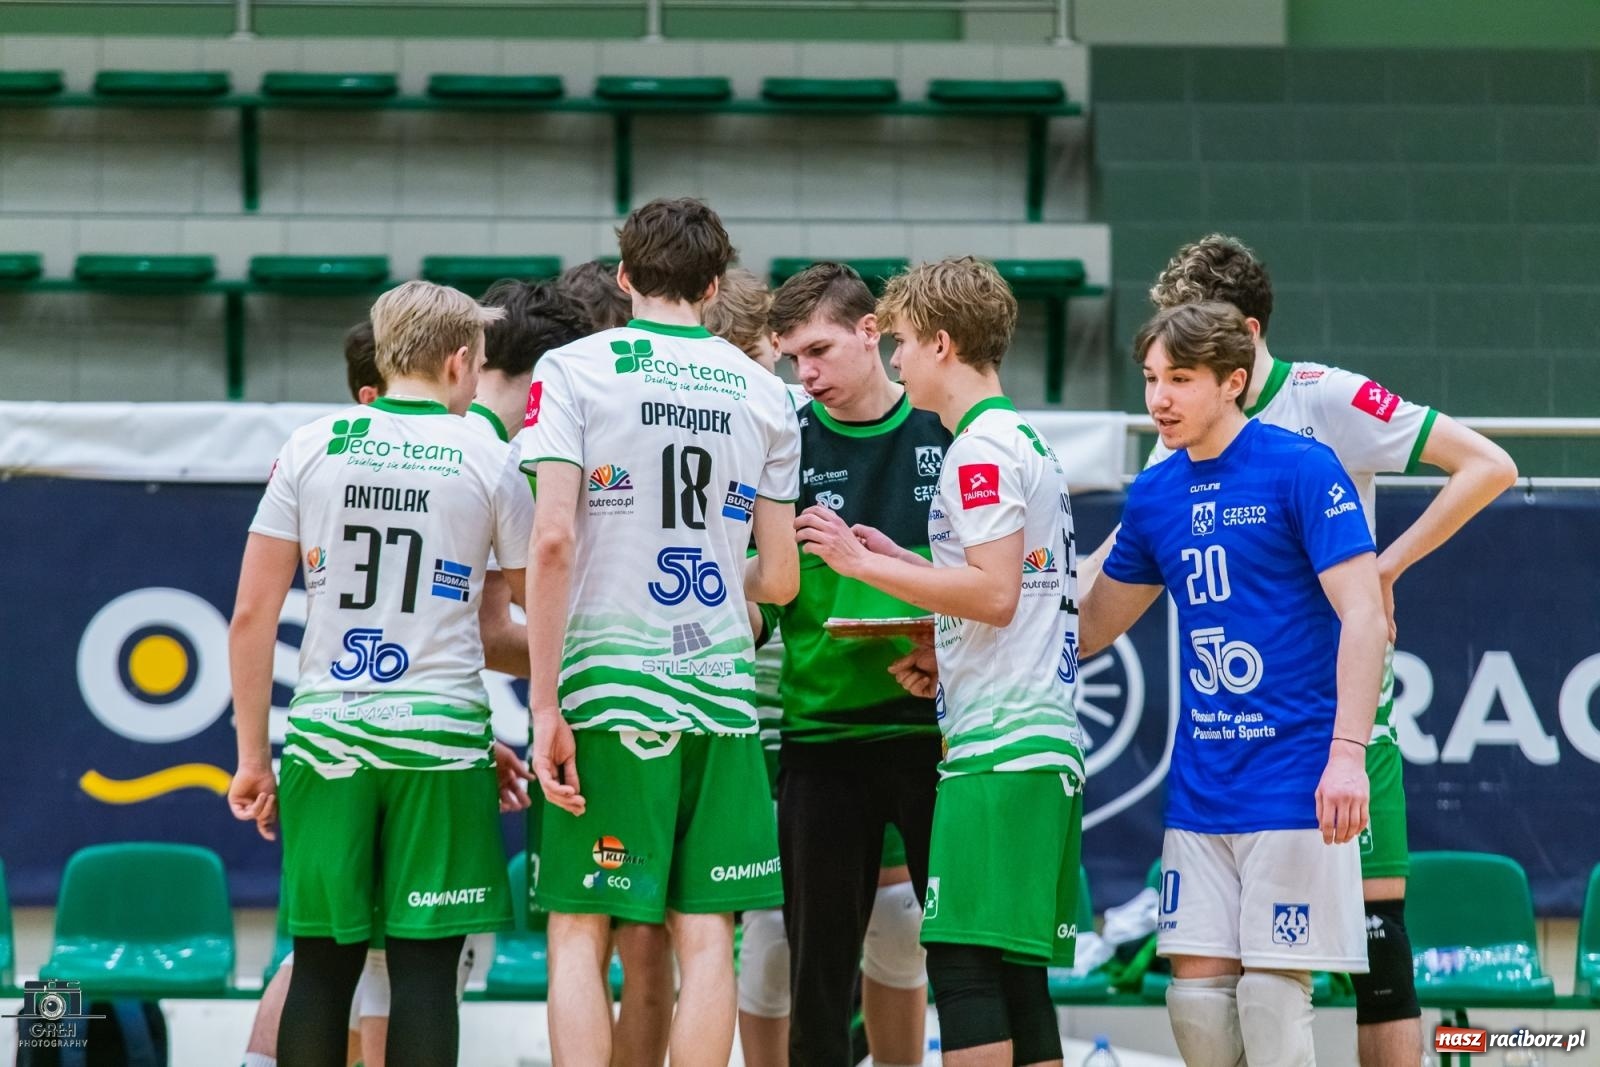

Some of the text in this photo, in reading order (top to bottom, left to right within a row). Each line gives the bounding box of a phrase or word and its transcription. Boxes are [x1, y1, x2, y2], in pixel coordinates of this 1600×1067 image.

[641, 359, 747, 390] eco-team
[641, 401, 732, 435] OPRZĄDEK
[349, 439, 463, 465] eco-team
[343, 485, 430, 512] ANTOLAK
[662, 443, 712, 530] 18
[963, 489, 996, 502] TAURON
[589, 496, 634, 508] outreco.pl
[339, 524, 424, 614] 37
[1181, 545, 1231, 606] 20
[1222, 725, 1236, 740] for
[1238, 724, 1276, 741] Sports
[607, 875, 631, 890] ECO
[407, 887, 487, 907] GAMINATE
